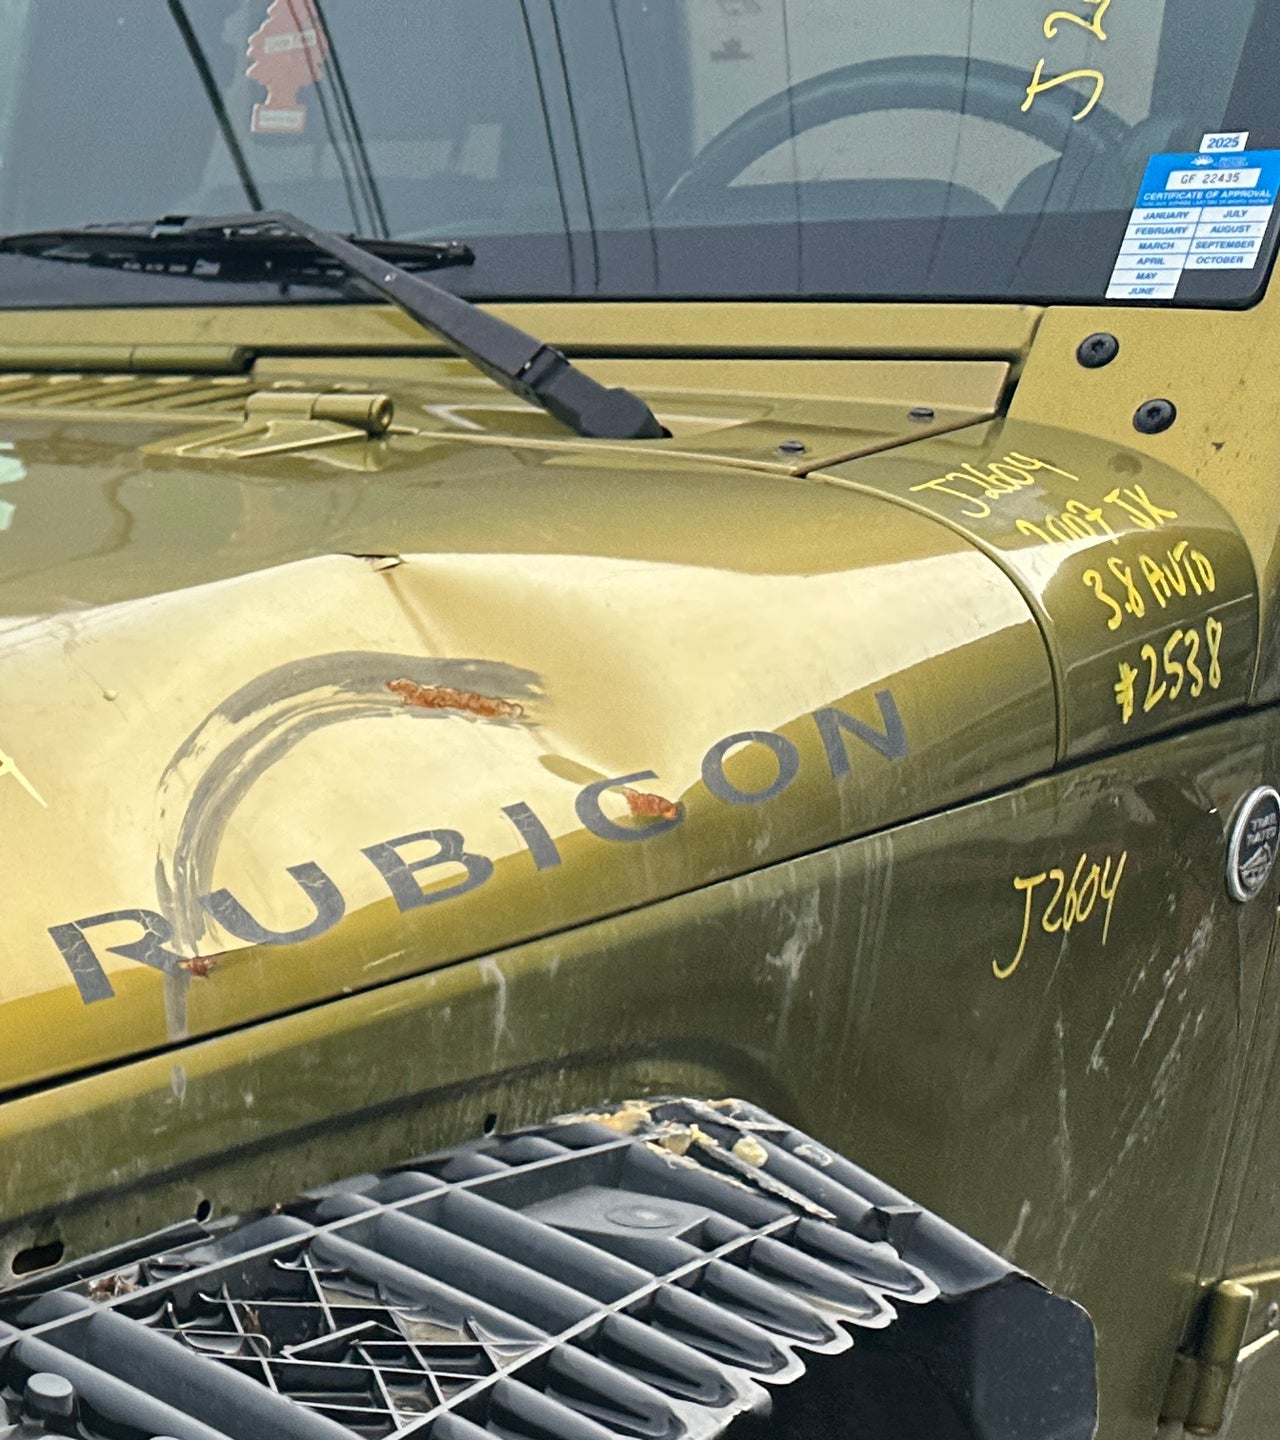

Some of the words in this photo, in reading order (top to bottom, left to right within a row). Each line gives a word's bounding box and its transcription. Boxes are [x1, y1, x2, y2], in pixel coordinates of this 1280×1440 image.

[1206, 136, 1240, 149] 2025
[1201, 172, 1241, 184] 22435
[1143, 191, 1202, 200] CERTIFICATE
[1205, 191, 1219, 199] OF
[1220, 189, 1272, 198] APPROVAL
[1143, 211, 1189, 220] JANUARY
[1223, 210, 1248, 218] JULY
[1134, 226, 1189, 235] FEBRUARY
[1210, 225, 1252, 233] AUGUST
[1138, 241, 1175, 250] MARCH
[1194, 240, 1255, 249] SEPTEMBER
[1136, 257, 1165, 265] APRIL
[1196, 256, 1244, 264] OCTOBER
[1136, 272, 1158, 280] MAY
[1128, 288, 1155, 296] JUNE
[1113, 616, 1223, 725] #2538
[47, 690, 910, 1006] RUBICON
[992, 850, 1127, 980] J2604
